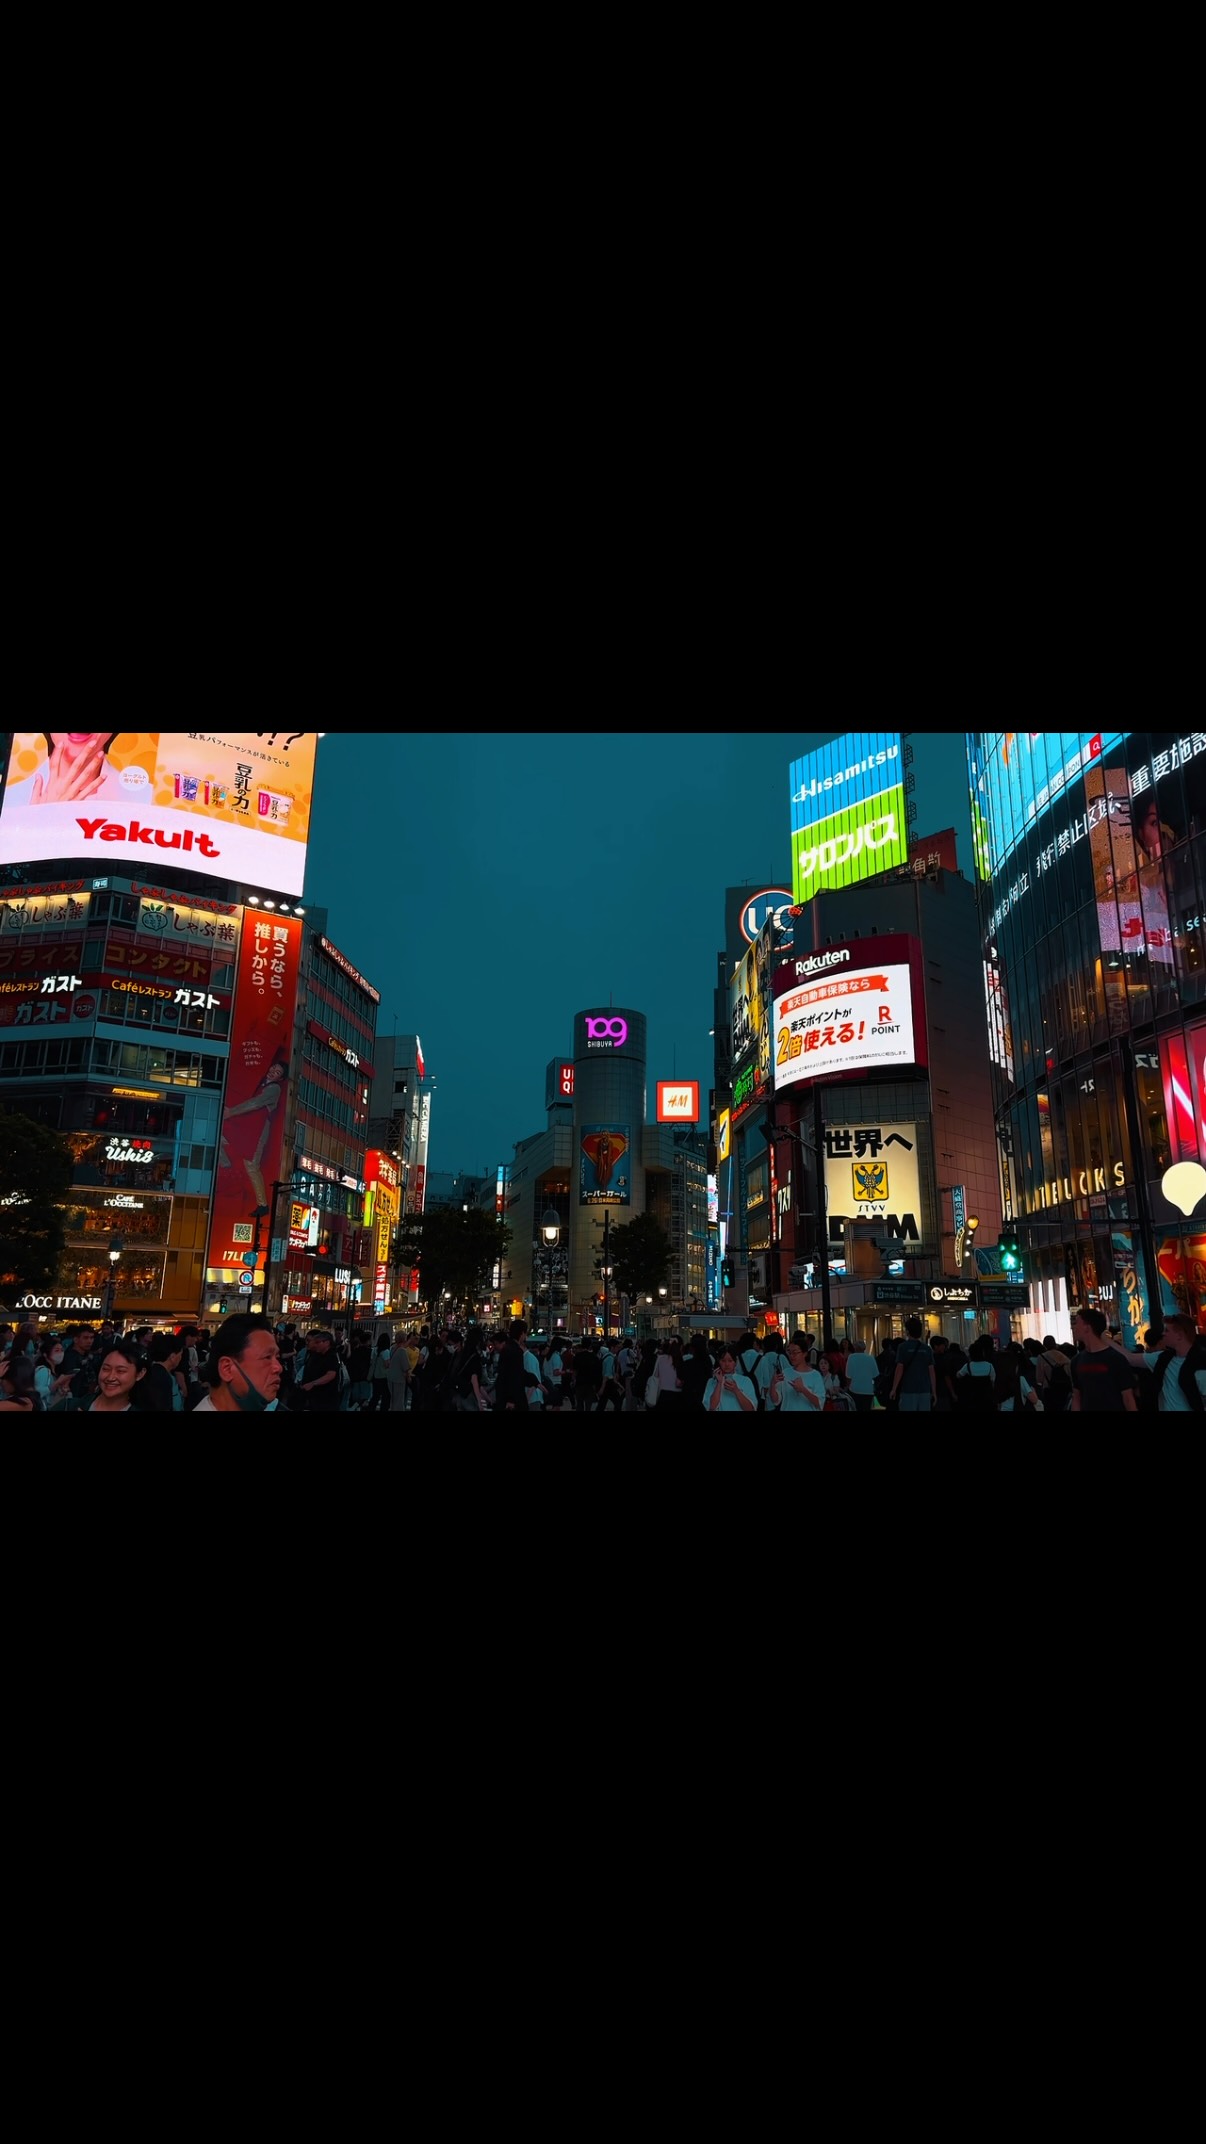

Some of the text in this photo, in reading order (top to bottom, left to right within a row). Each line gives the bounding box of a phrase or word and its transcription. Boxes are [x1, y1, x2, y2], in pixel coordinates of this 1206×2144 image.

[229, 762, 254, 810] 豆乳の力
[792, 744, 899, 803] Hisamitsu
[75, 818, 220, 858] Yakult
[799, 813, 899, 879] サロンパス
[31, 902, 84, 923] しゃぶ葉
[173, 913, 236, 942] しゃぶ葉
[106, 944, 207, 978] コンタクト
[252, 921, 271, 995] 推しから。
[270, 925, 289, 998] 買うなら、
[795, 949, 850, 976] Rakuten
[41, 975, 82, 994] ガスト
[174, 988, 220, 1010] ガスト
[786, 979, 871, 1009] 楽天自動車保険なら
[15, 1001, 67, 1024] ガスト
[790, 1008, 853, 1034] 楽天ポイントが
[585, 1017, 627, 1047] 109
[871, 1024, 901, 1035] POINT
[110, 1137, 130, 1147] 渋谷
[824, 1128, 914, 1159] 世界へ
[582, 1190, 627, 1198] スーパーガール
